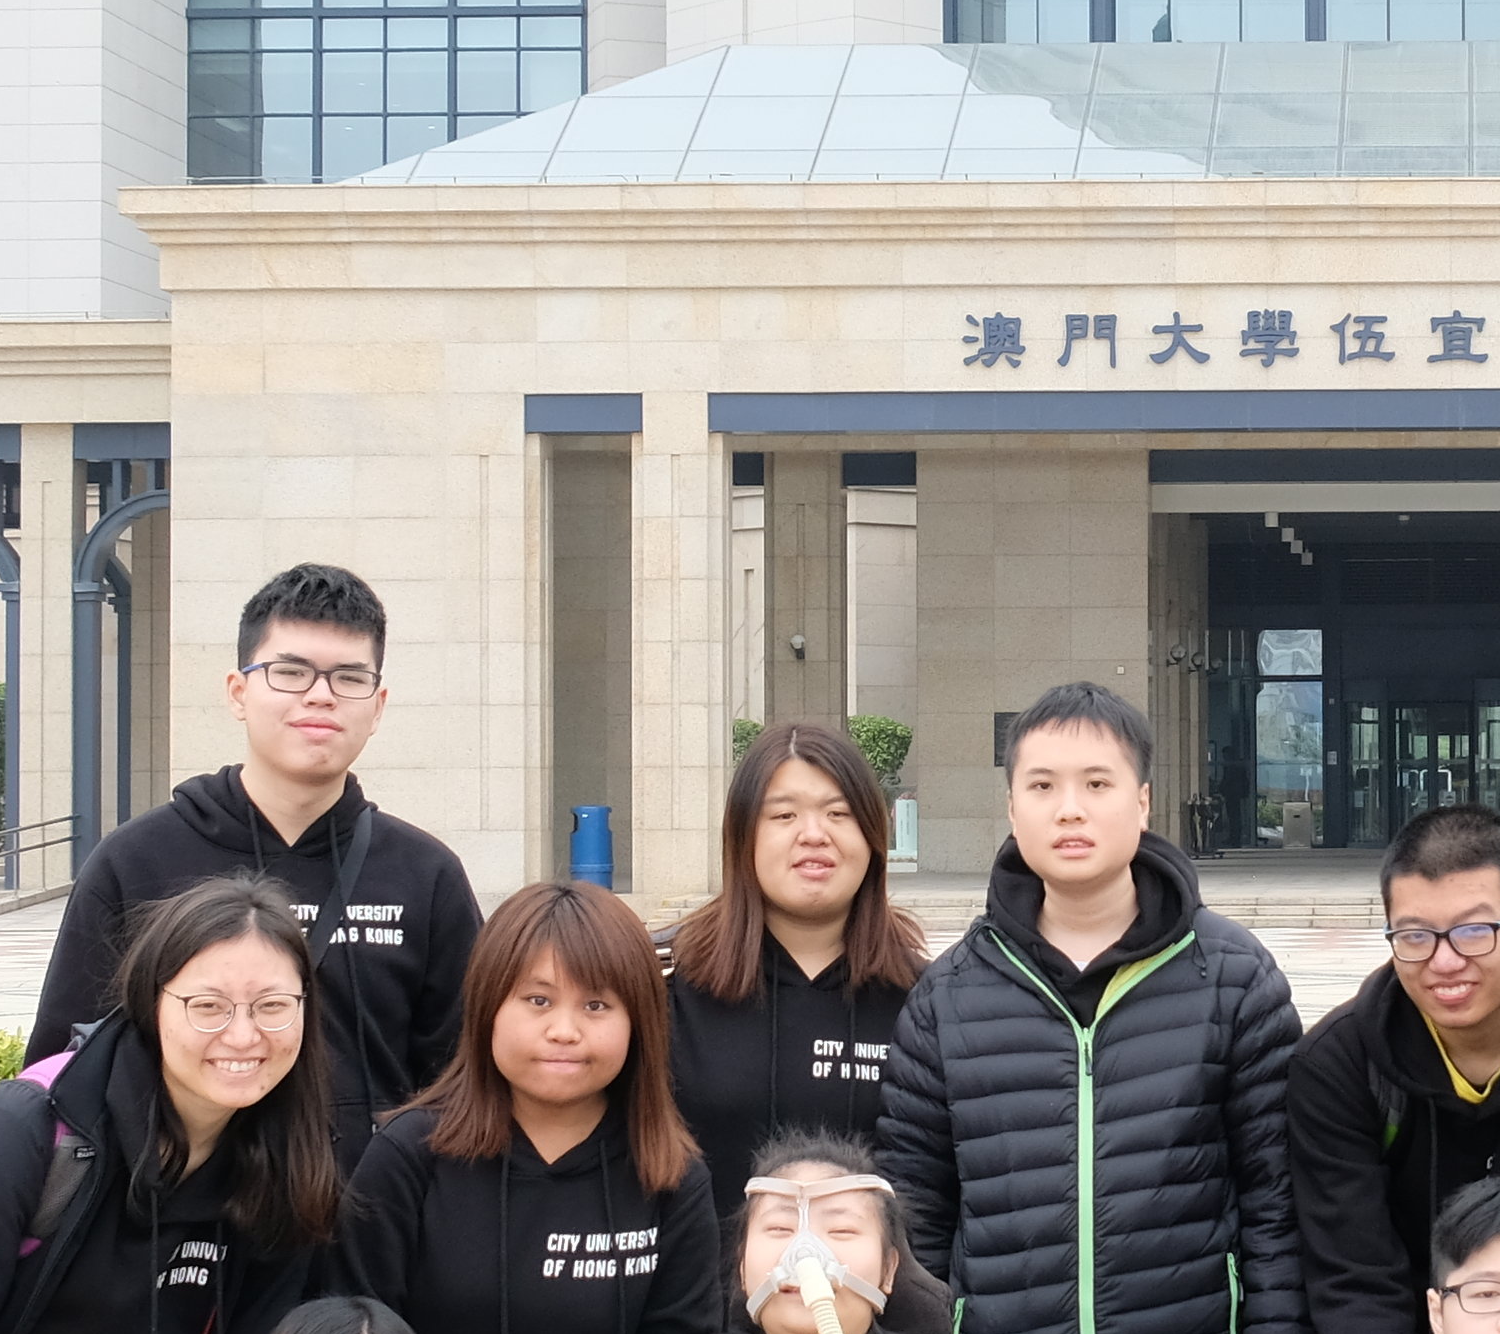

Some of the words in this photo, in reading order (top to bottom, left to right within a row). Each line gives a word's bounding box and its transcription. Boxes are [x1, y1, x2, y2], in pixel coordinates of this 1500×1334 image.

[340, 904, 404, 922] VERSITY
[365, 927, 404, 945] KONG
[813, 1039, 844, 1057] CITY
[812, 1060, 833, 1078] OF
[546, 1233, 581, 1253] CITY
[169, 1266, 209, 1286] HONG
[543, 1259, 566, 1278] OF
[572, 1259, 617, 1280] HONG
